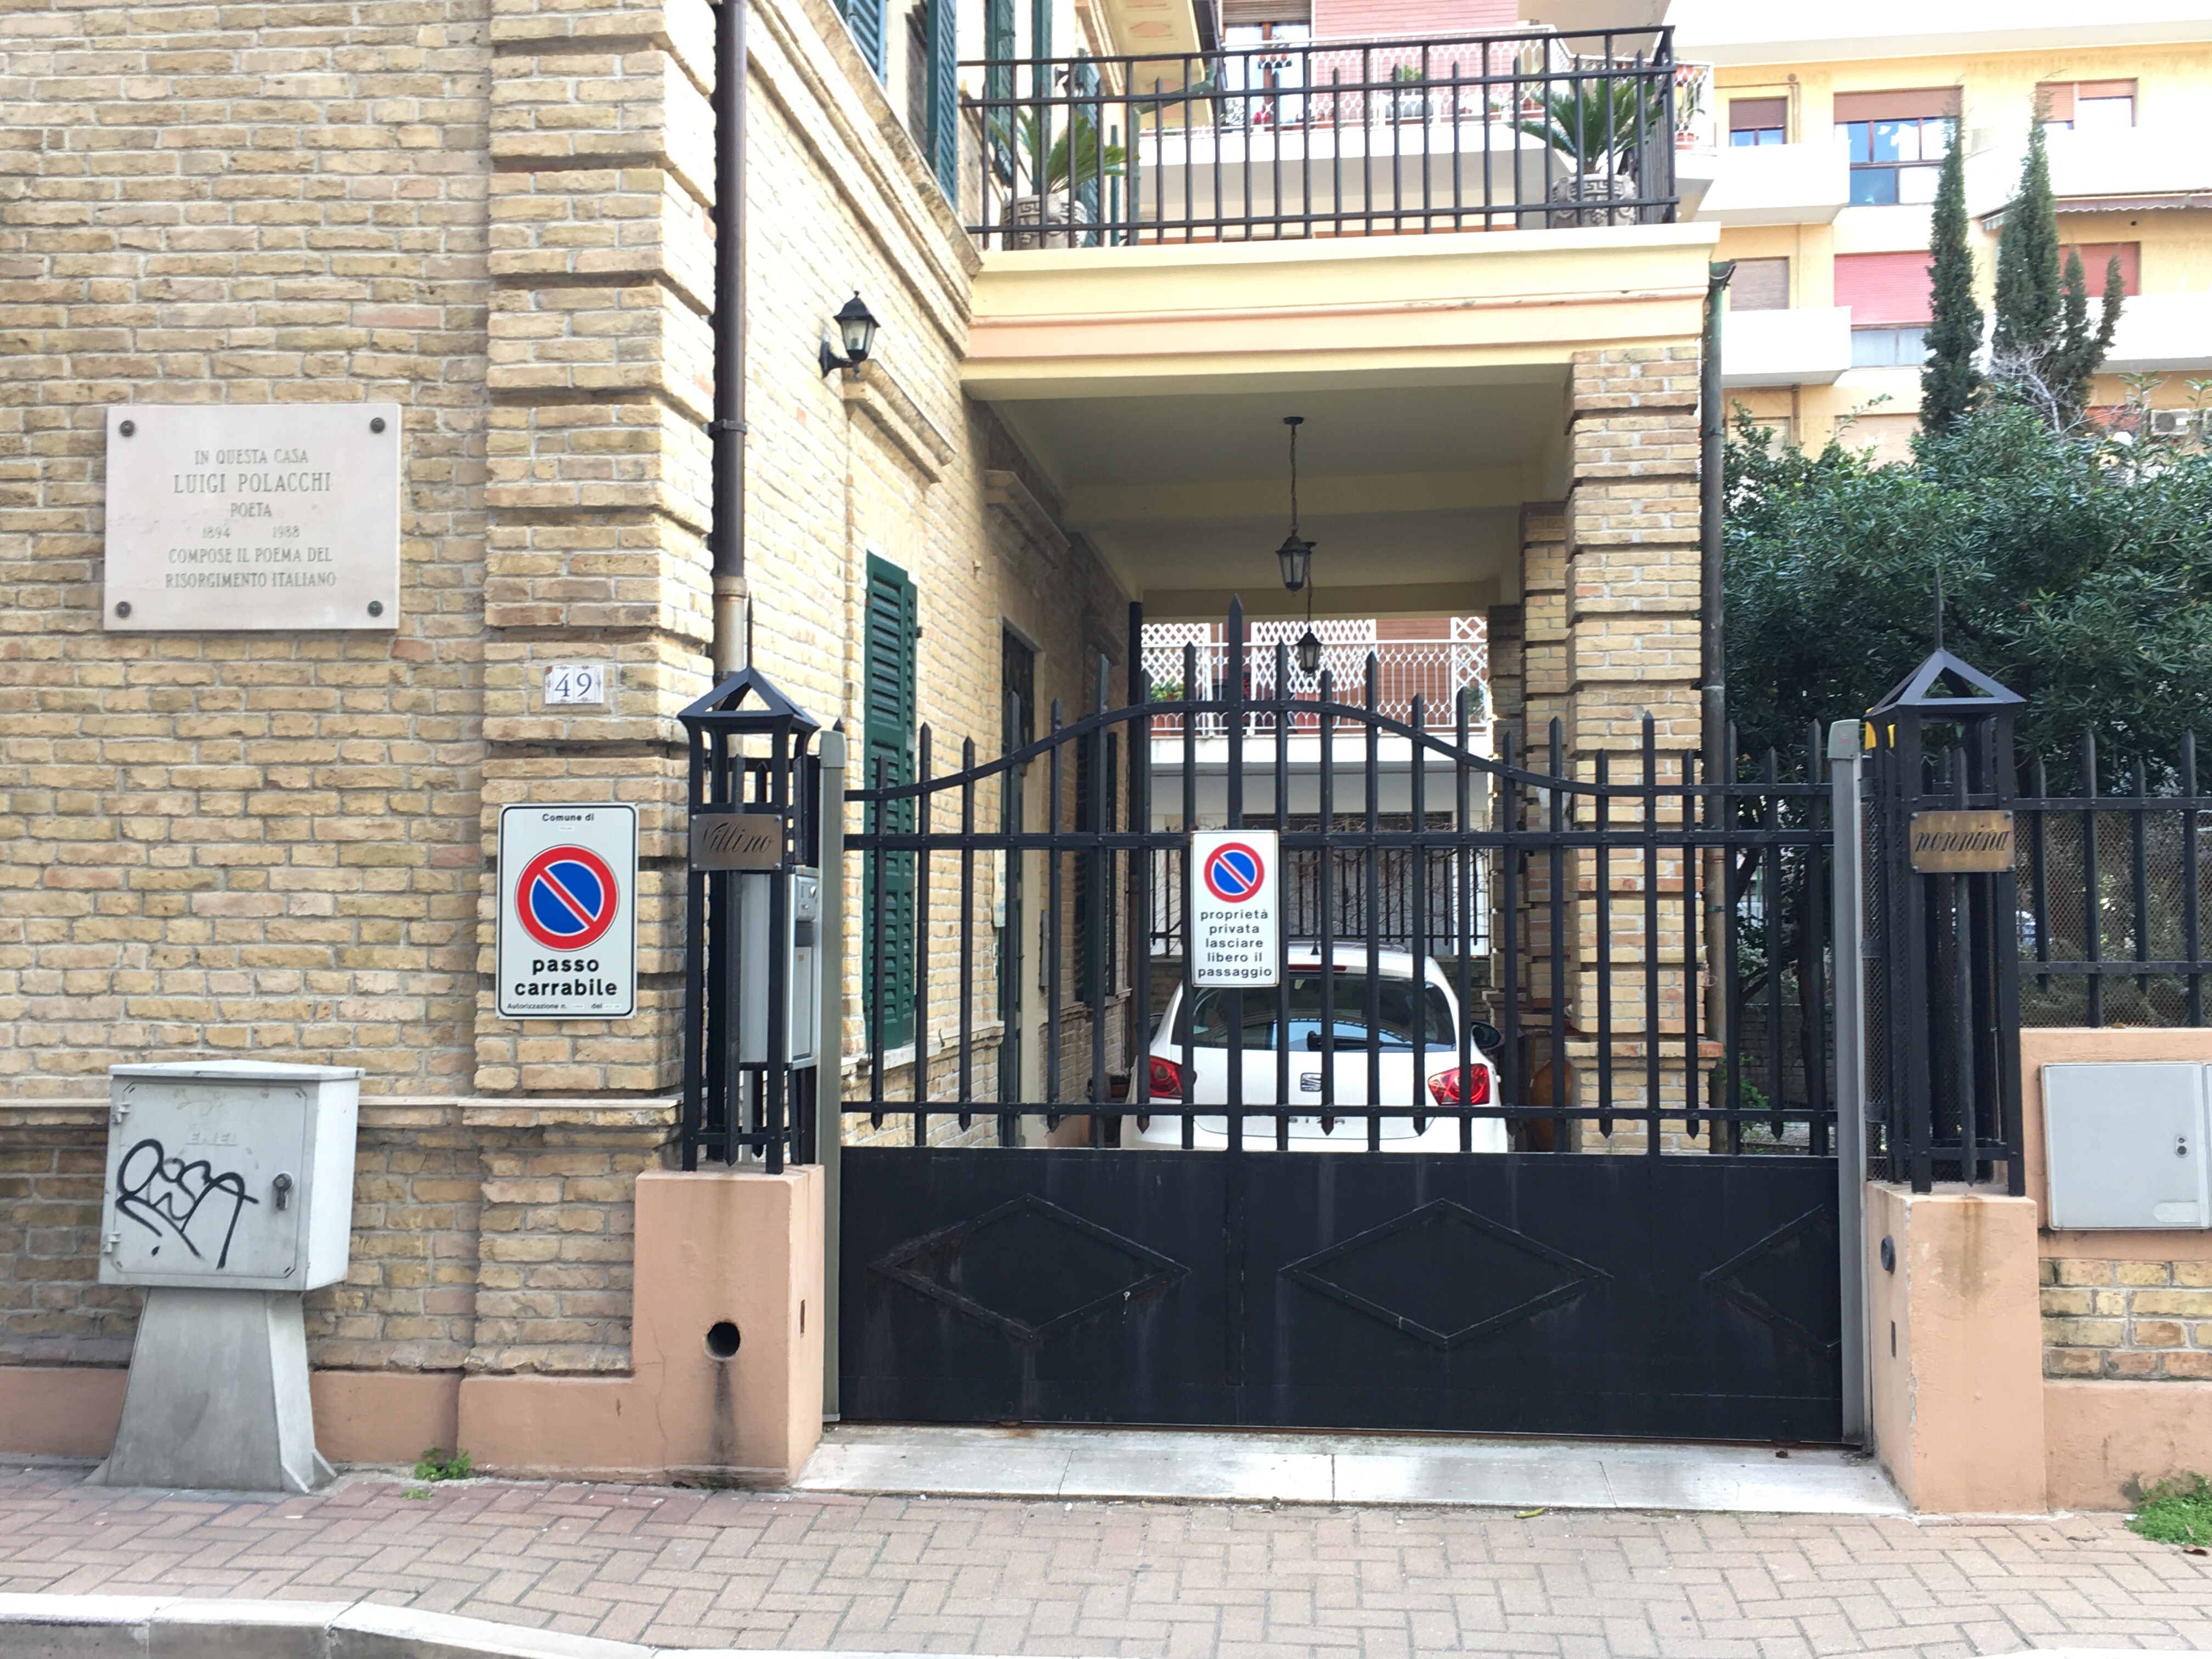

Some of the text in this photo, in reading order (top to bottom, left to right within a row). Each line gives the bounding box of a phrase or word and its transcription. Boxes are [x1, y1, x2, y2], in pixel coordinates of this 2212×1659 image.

[194, 448, 308, 465] IN QUESTA CASA
[173, 472, 331, 493] LUIGI POLACCHI
[230, 502, 273, 517] POETA
[202, 526, 230, 539] 1894
[168, 546, 332, 564] COMPOSE IL POEMA DEL
[165, 572, 337, 588] RISORGIMENTO ITALIANO
[554, 673, 592, 697] 49
[542, 812, 594, 822] Comune di
[702, 822, 775, 853] Villino
[1914, 825, 2010, 852] nonnina
[1200, 909, 1268, 922] proprietà
[1209, 923, 1260, 936] privata
[1205, 938, 1263, 948] lasciare
[1207, 952, 1262, 962] libero il
[532, 958, 599, 975] passo
[1198, 966, 1272, 979] passaggio
[514, 978, 618, 996] carrabile
